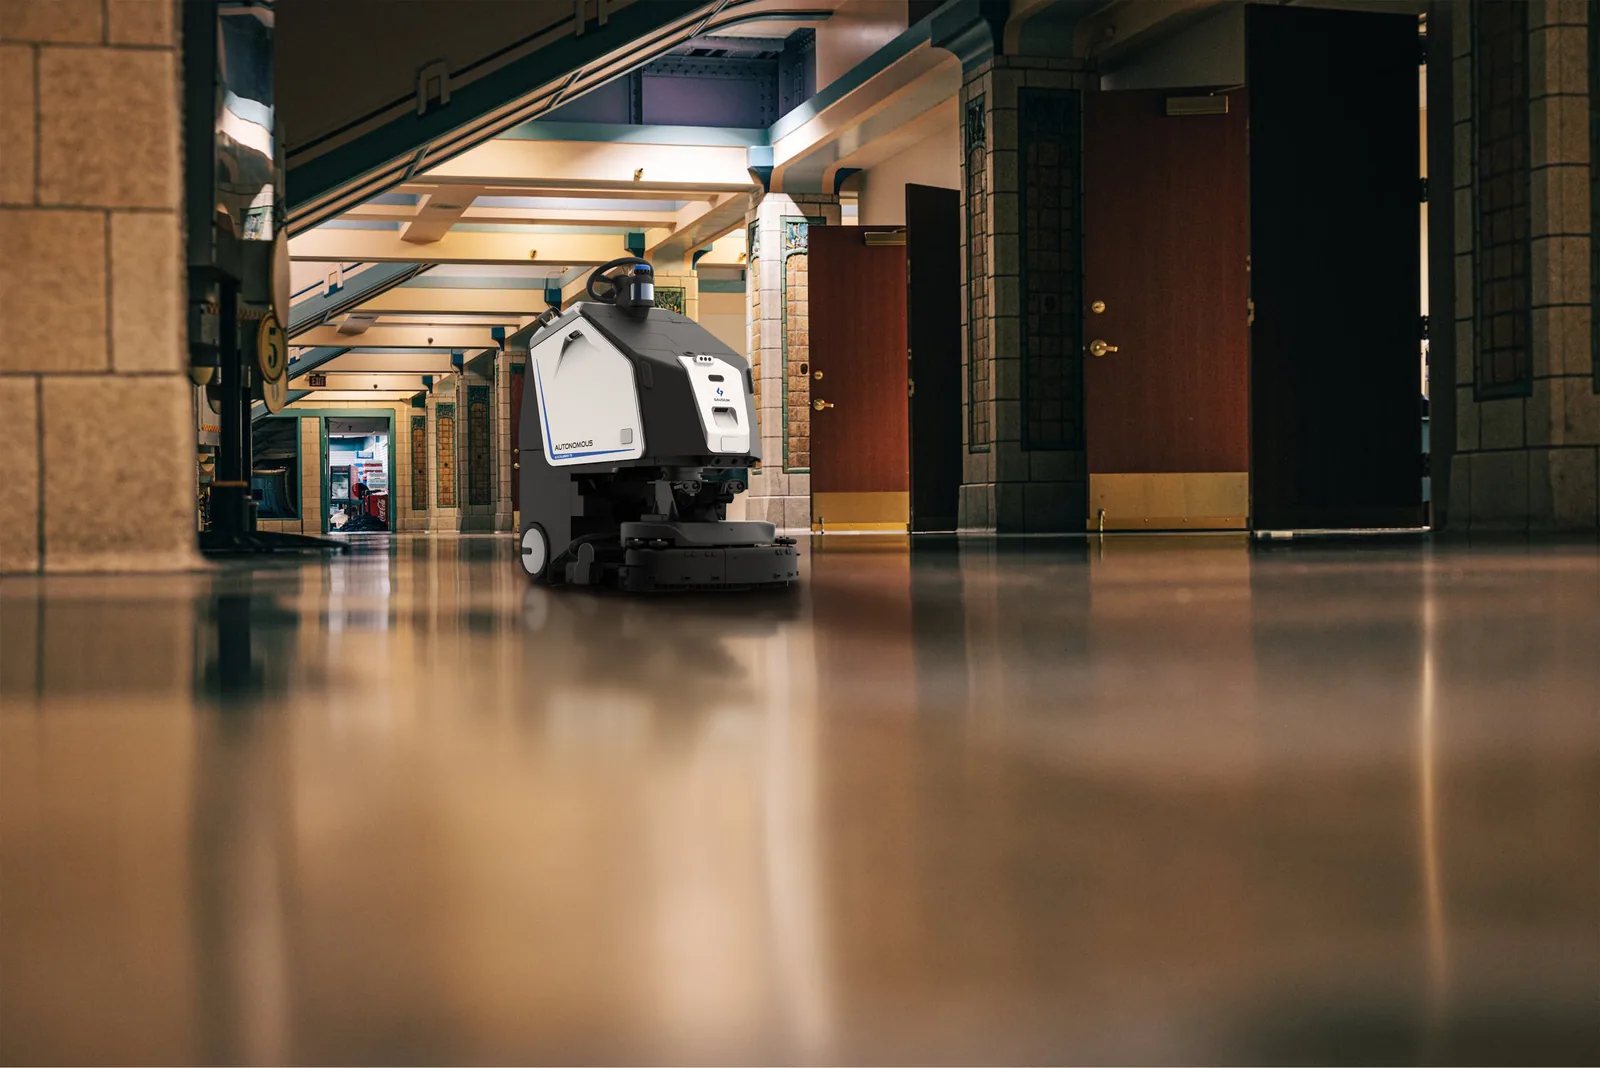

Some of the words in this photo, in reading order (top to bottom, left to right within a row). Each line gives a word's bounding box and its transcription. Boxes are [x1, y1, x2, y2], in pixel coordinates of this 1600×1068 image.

[268, 326, 278, 369] 5
[311, 376, 326, 385] EXIT
[554, 439, 593, 451] AUTONOMOUS
